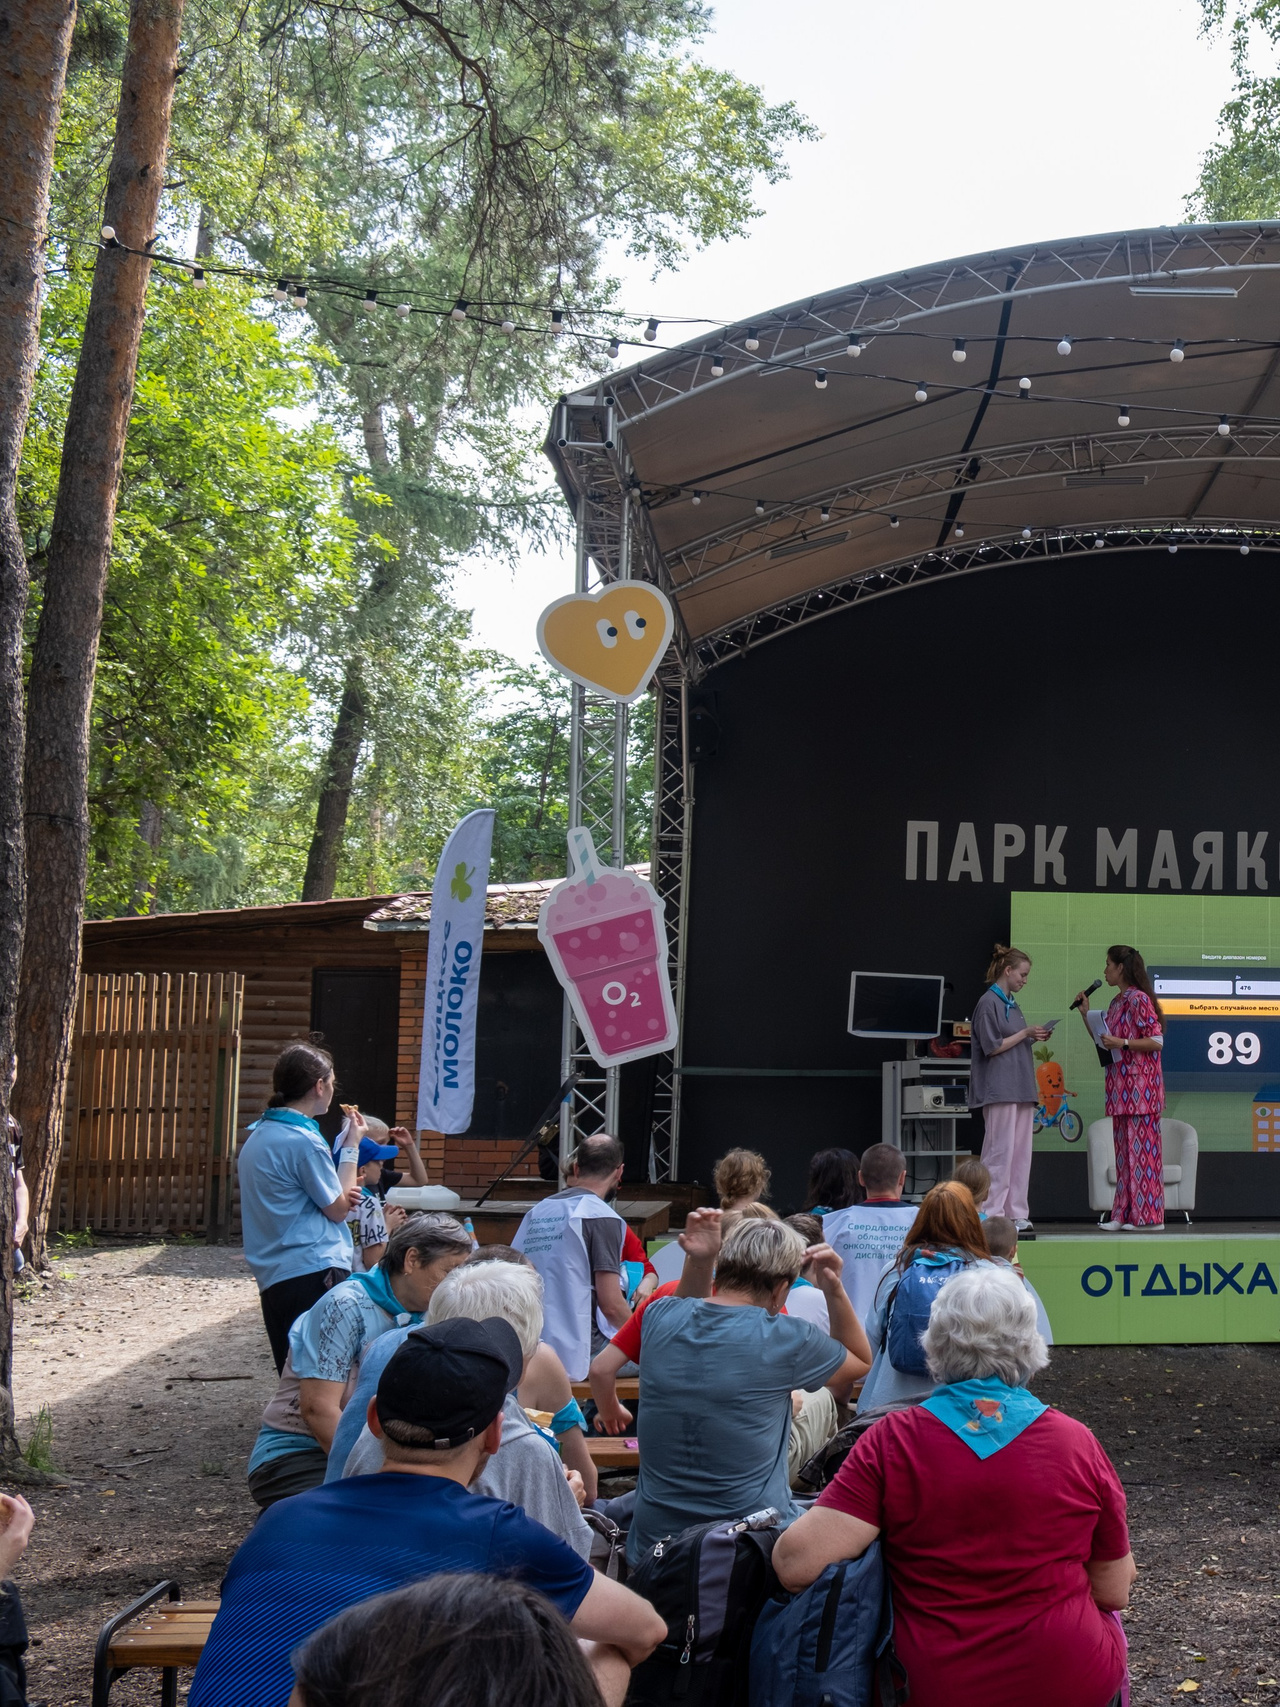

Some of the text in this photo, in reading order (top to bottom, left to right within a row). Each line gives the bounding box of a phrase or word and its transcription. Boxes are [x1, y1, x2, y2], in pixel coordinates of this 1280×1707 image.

[906, 820, 1067, 885] ПАРК
[1207, 1031, 1261, 1065] 89
[847, 1222, 911, 1232] Свердловски
[857, 1233, 905, 1241] областной
[843, 1243, 904, 1251] онкологичес
[854, 1252, 898, 1260] диспансе
